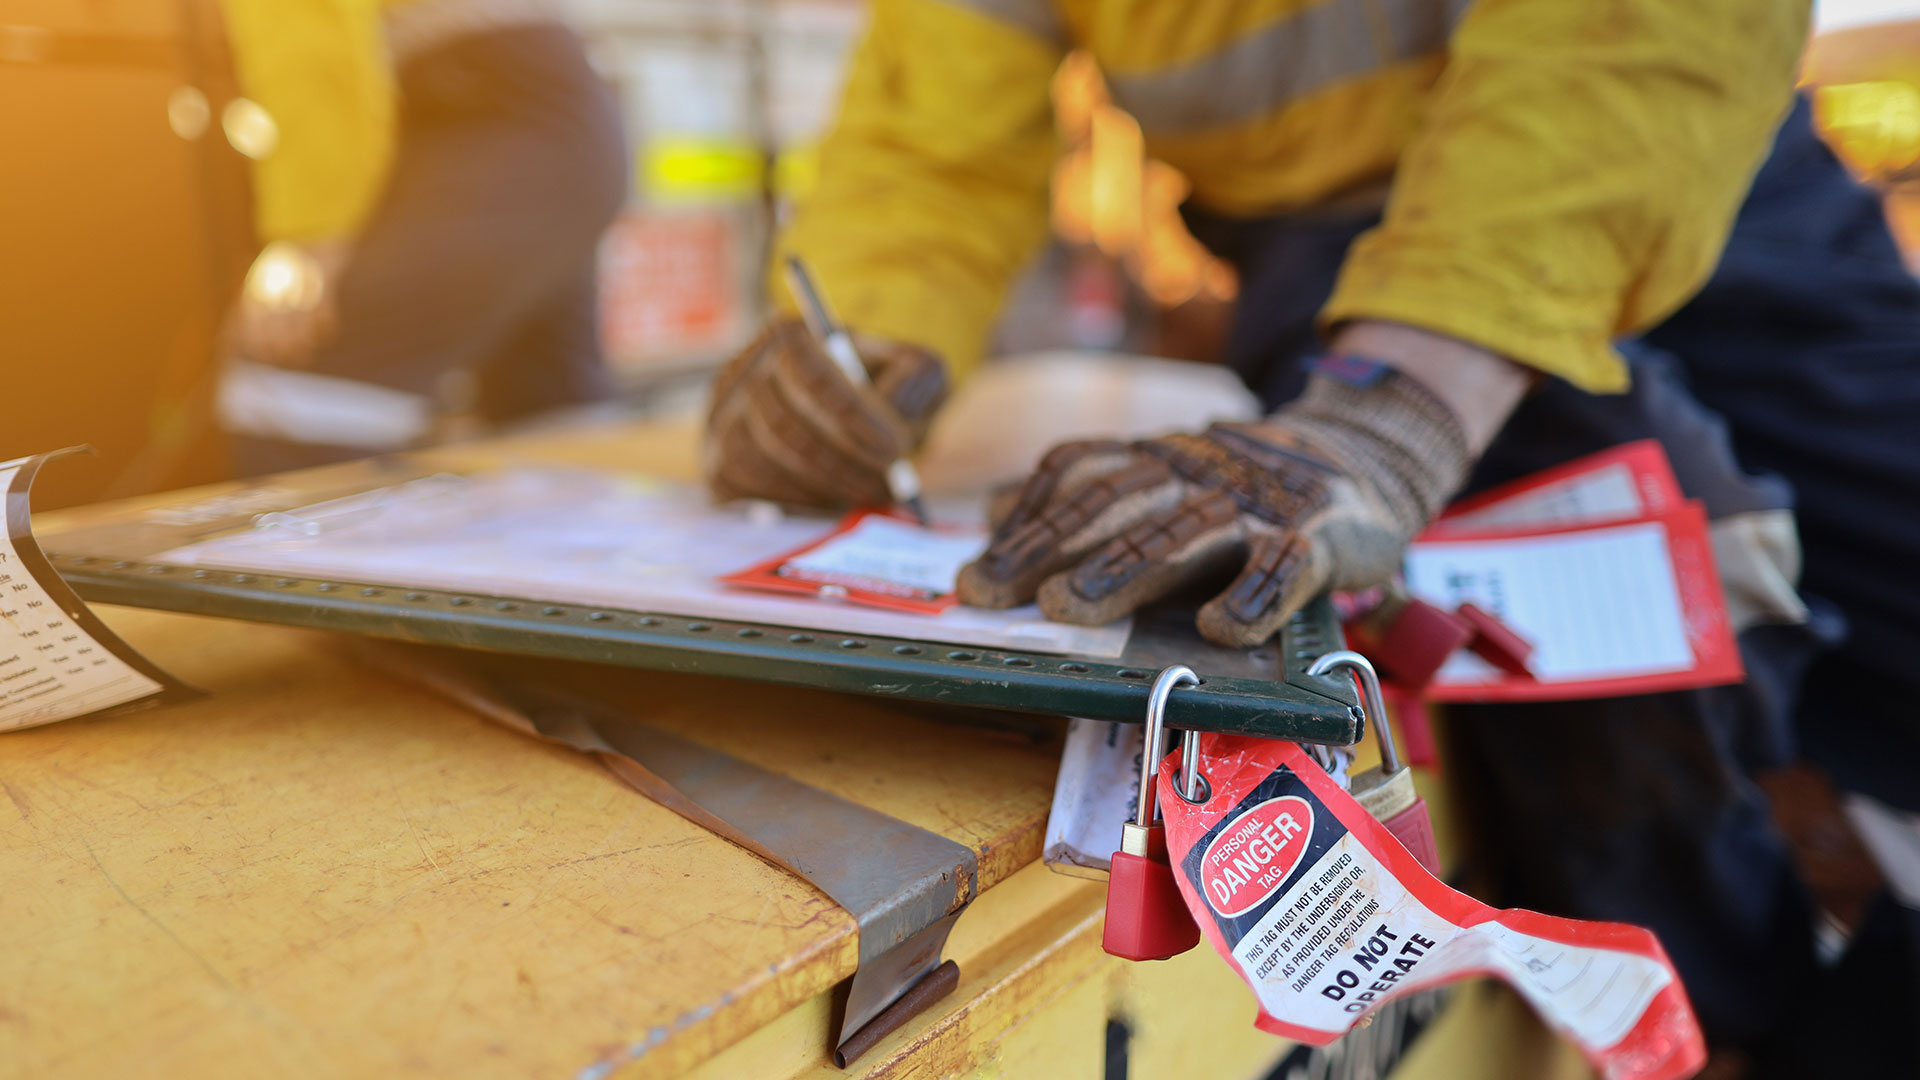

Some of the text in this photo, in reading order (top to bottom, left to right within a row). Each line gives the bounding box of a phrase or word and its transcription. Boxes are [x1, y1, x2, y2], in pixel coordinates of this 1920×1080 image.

[12, 584, 28, 592] No
[27, 600, 43, 608] No
[1211, 817, 1264, 867] PERSONAL
[1211, 812, 1303, 906] DANGER
[1256, 865, 1283, 889] TAG
[1245, 853, 1352, 963] THIS TAG MUST NOT BE REMOVED
[1256, 948, 1284, 979] EXCEPT
[1280, 937, 1294, 952] BY
[1290, 922, 1310, 940] THE
[1305, 876, 1353, 925] UNDERSIGNED
[1282, 889, 1365, 979] AS PROVIDED UNDER THE
[1291, 898, 1380, 993] DANGER TAG REGULATIONS
[1320, 923, 1398, 1002] DO NOT
[1344, 933, 1436, 1013] OPERATE
